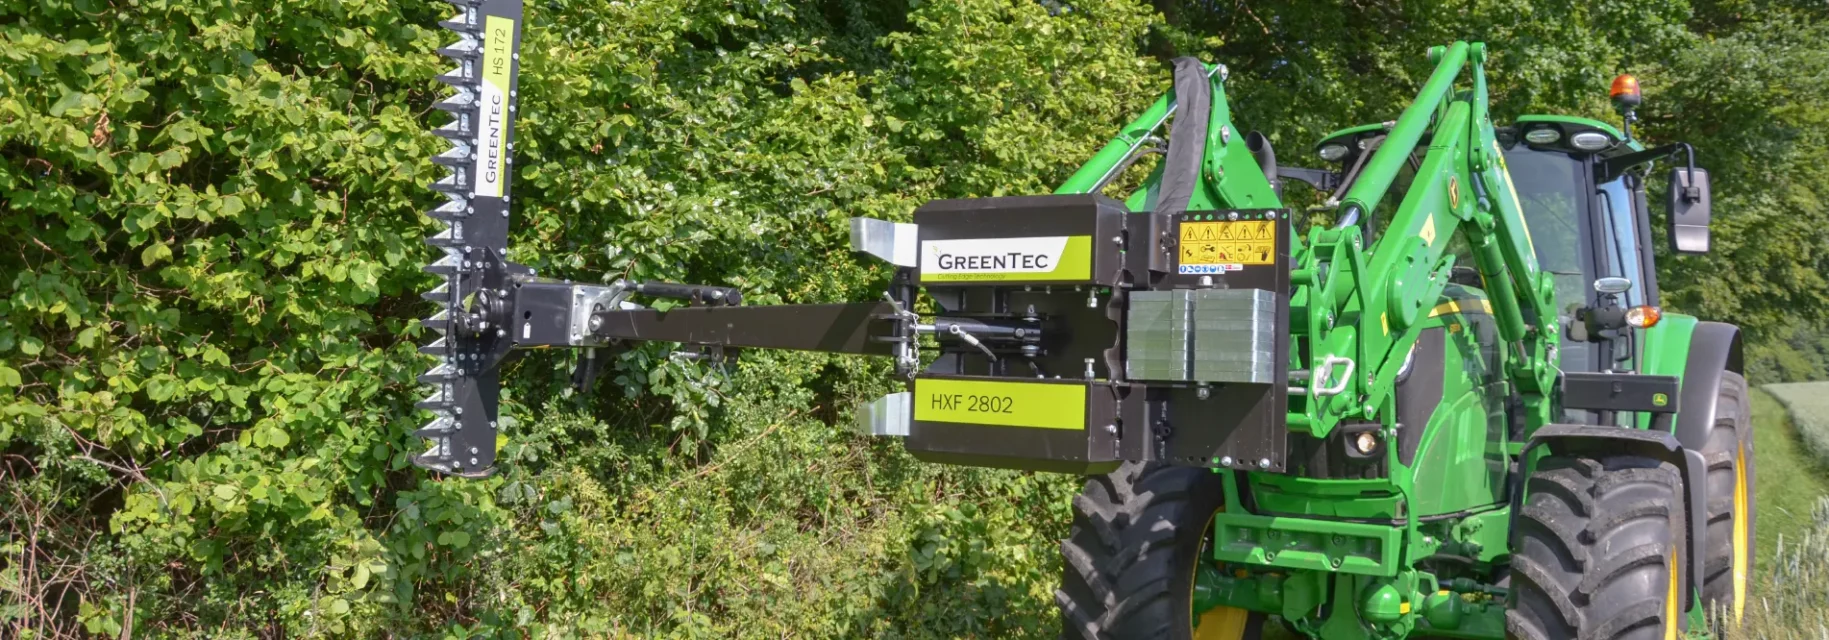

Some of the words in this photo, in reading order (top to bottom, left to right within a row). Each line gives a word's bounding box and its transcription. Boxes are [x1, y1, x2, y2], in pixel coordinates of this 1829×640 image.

[494, 28, 506, 54] 172
[492, 57, 504, 76] HS
[931, 393, 963, 410] HXF
[967, 394, 1013, 414] 2802
